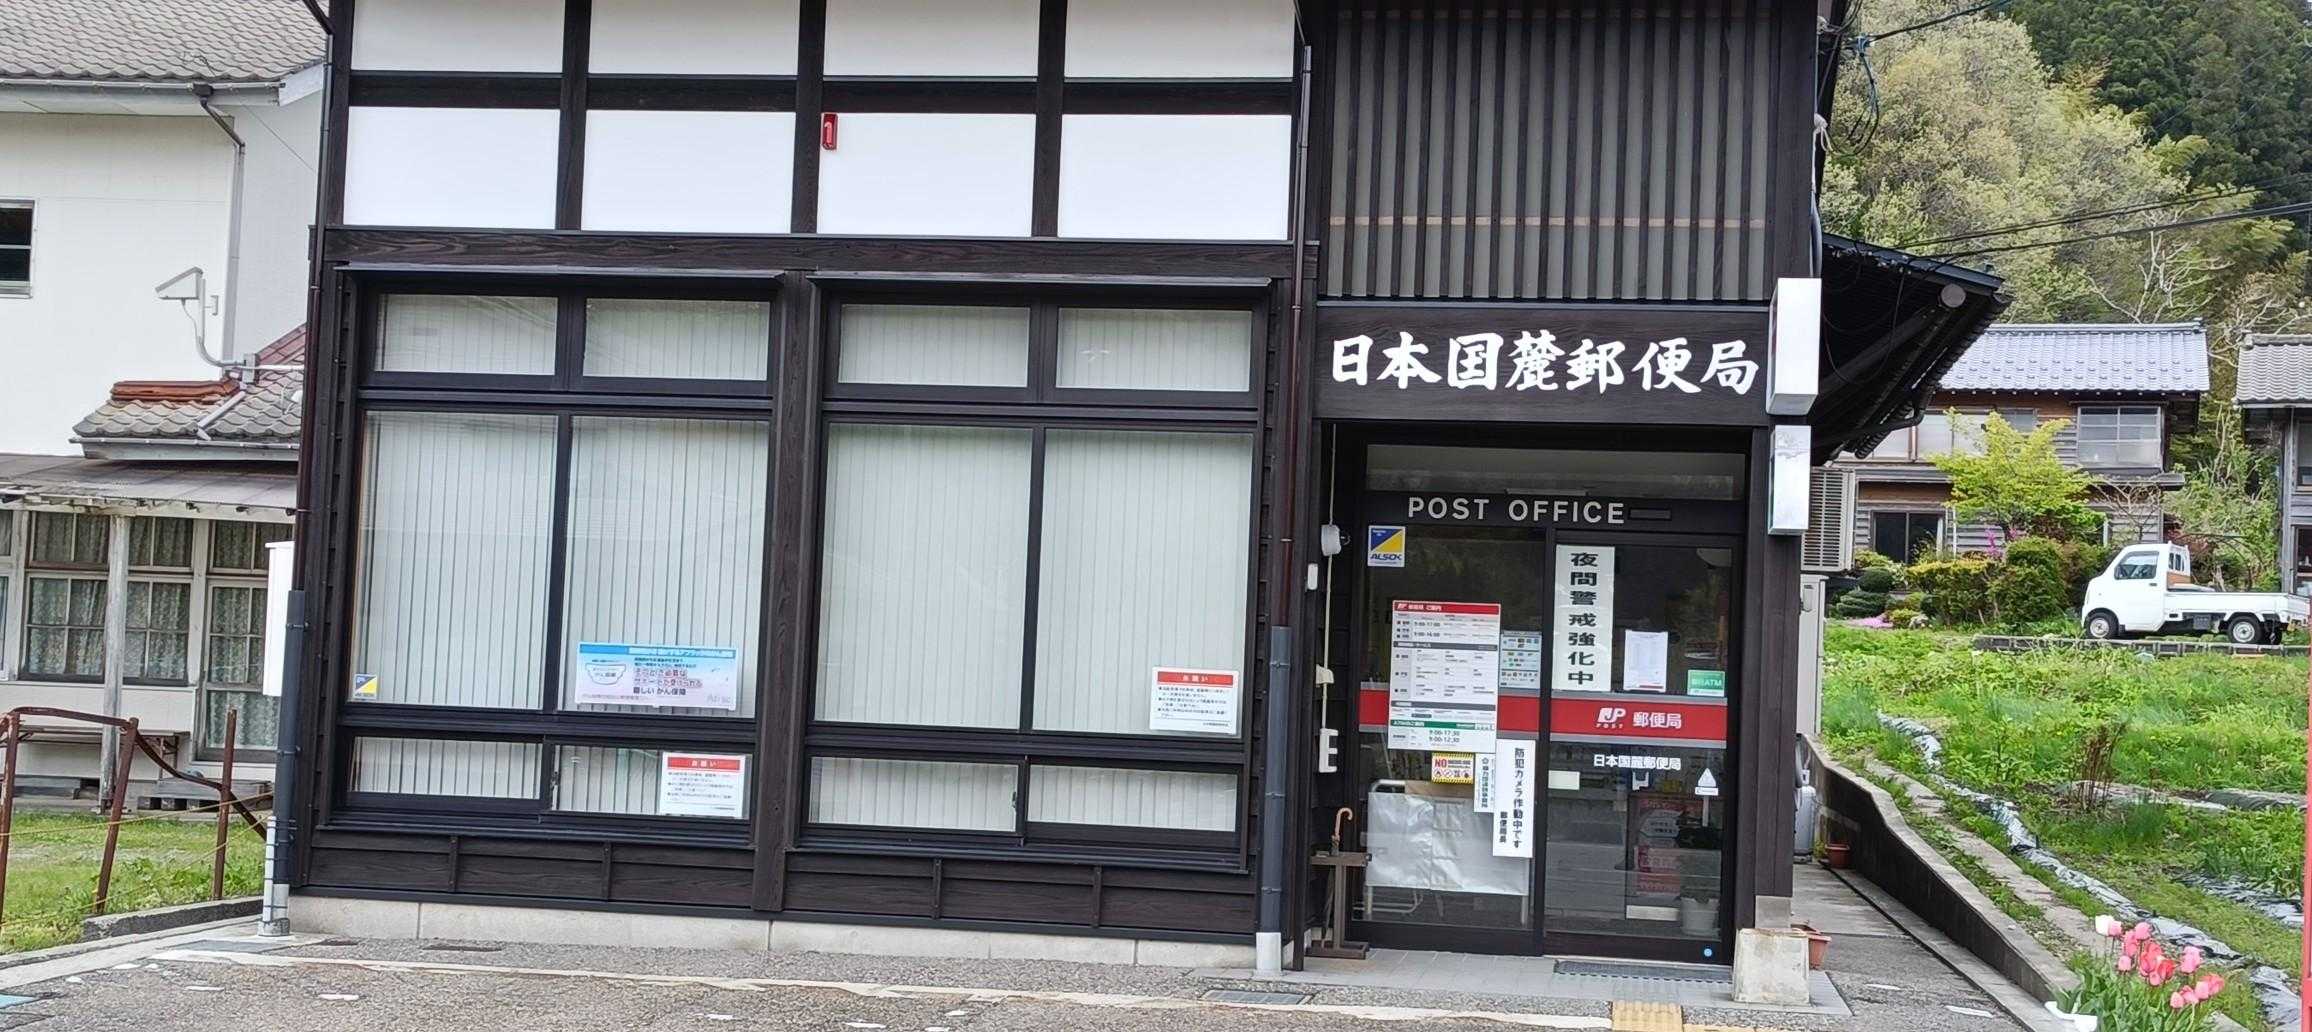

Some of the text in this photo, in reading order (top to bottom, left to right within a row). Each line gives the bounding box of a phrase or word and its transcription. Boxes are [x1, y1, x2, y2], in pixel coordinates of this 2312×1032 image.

[1331, 329, 1760, 396] 日本国麓郵便局
[1407, 497, 1625, 524] POST OFFICE
[1567, 552, 1599, 686] 夜間警戒強化中
[1632, 711, 1682, 729] 郵便局
[1593, 754, 1682, 771] 日本国麓郵便局
